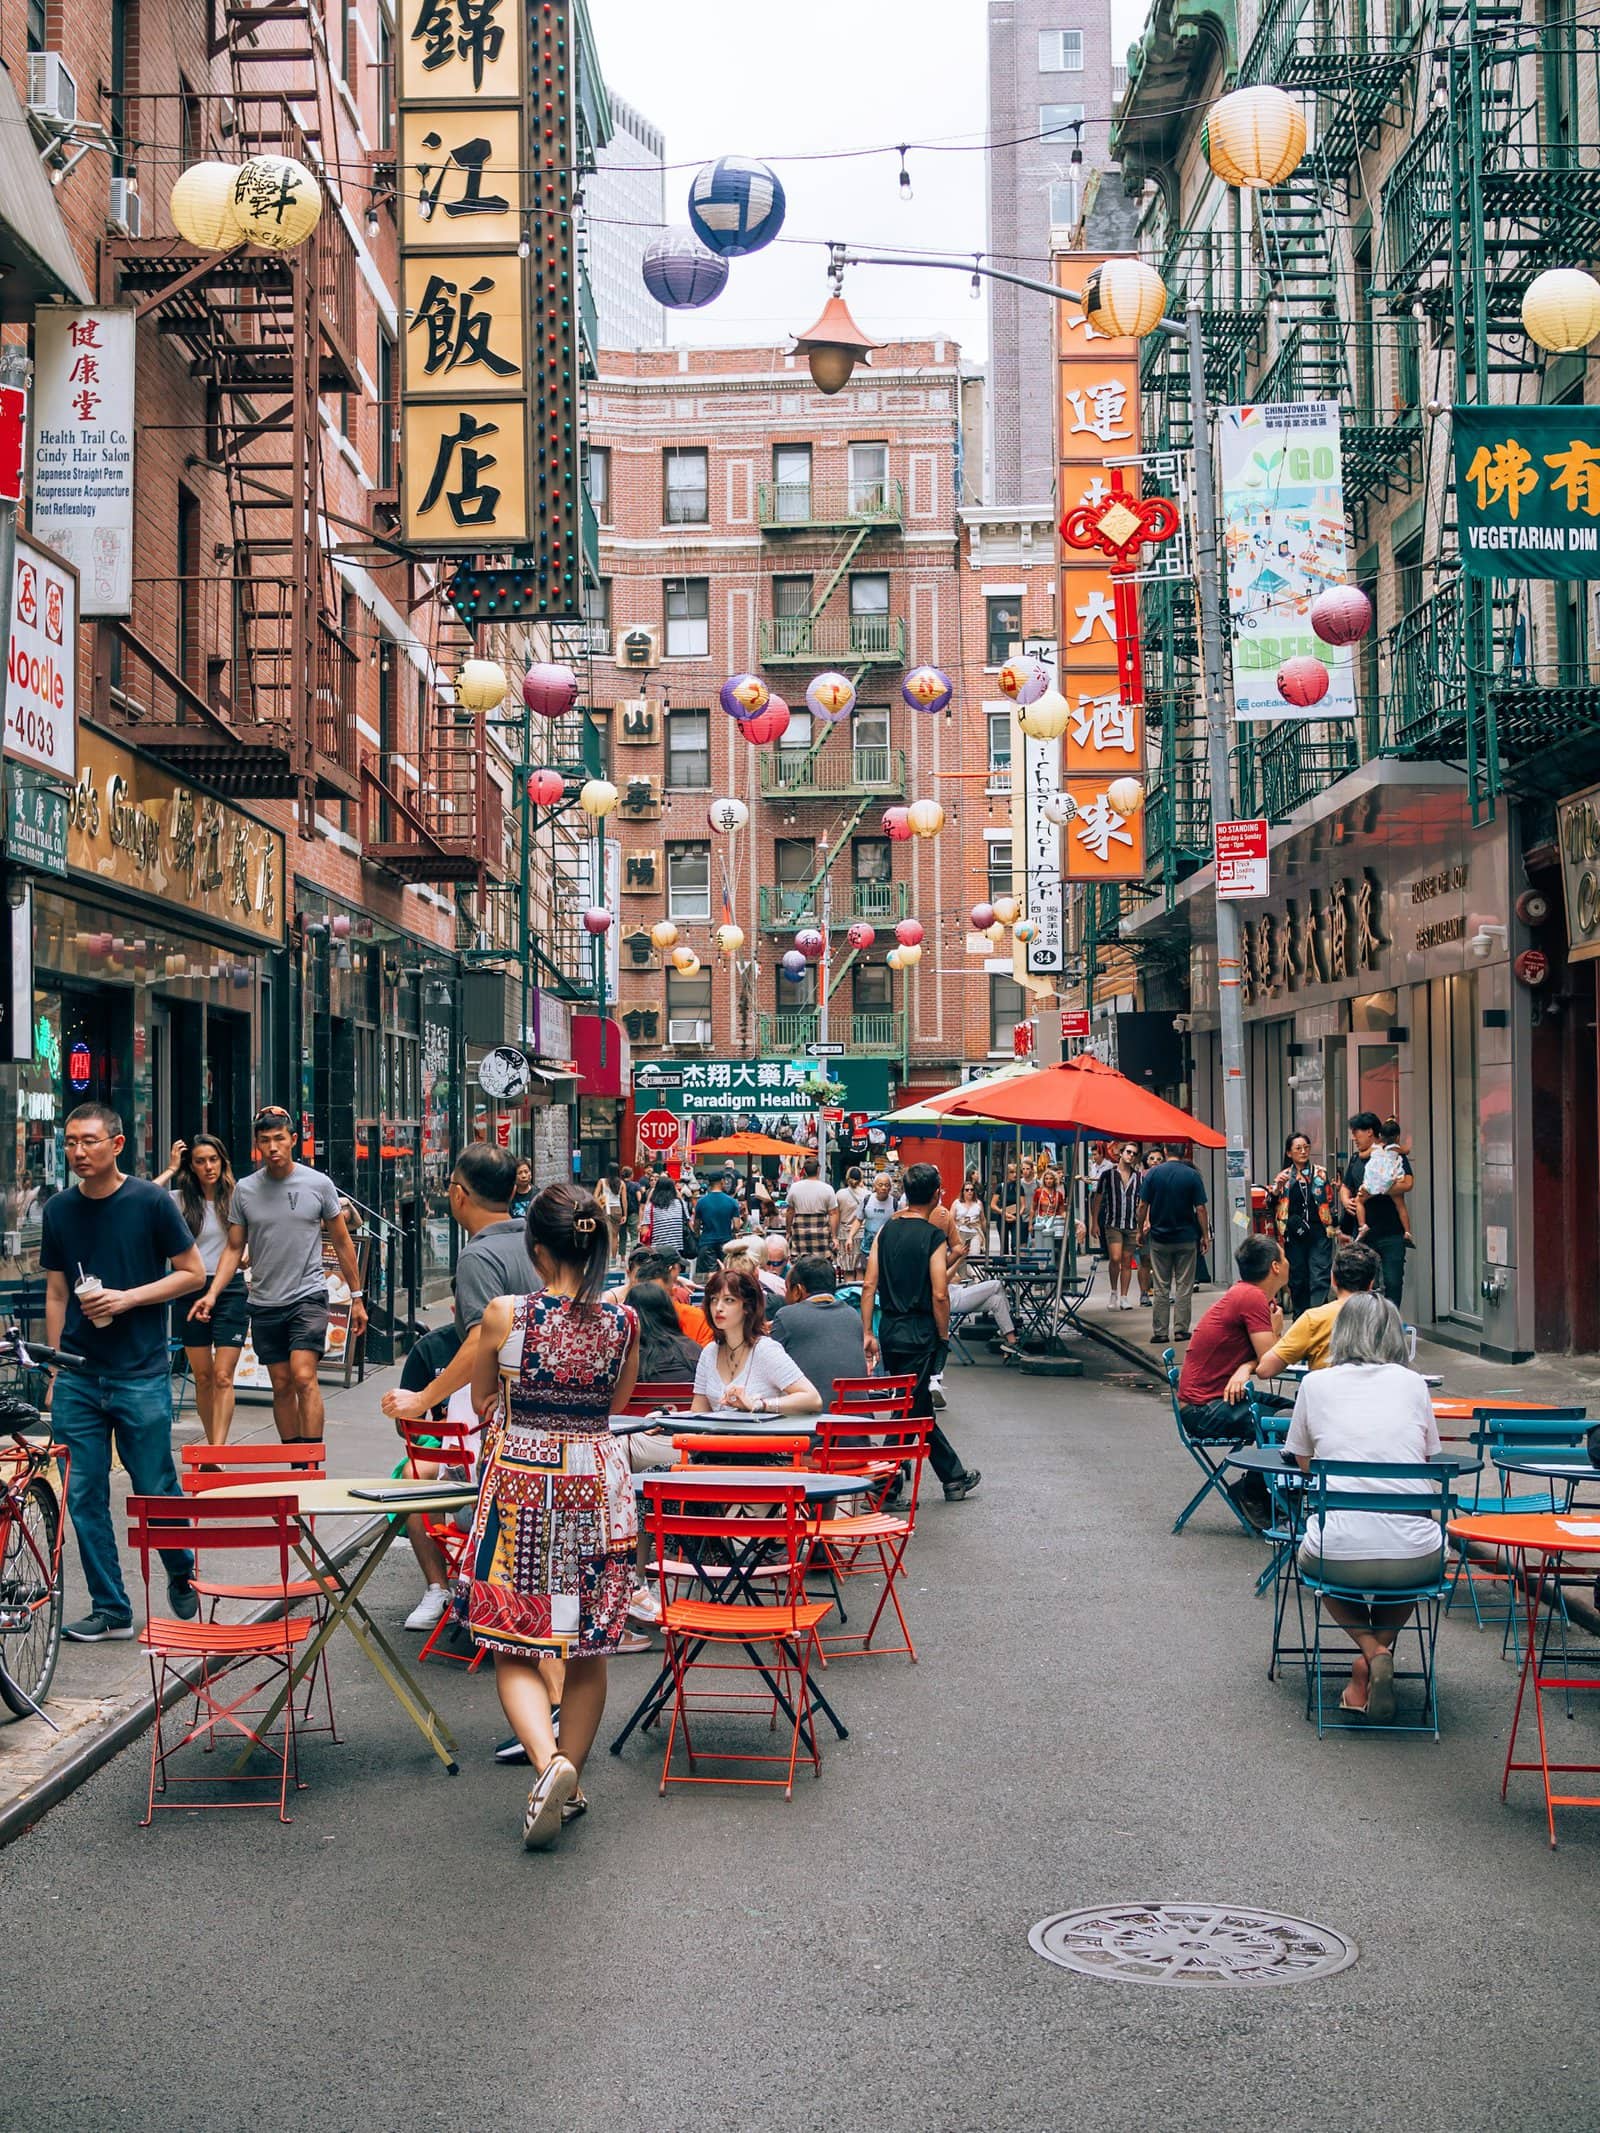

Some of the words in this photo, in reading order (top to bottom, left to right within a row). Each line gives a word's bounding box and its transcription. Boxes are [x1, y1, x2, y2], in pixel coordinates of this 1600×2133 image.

[408, 0, 521, 527] 錦江飯店
[66, 319, 104, 420] 健康堂
[1265, 404, 1309, 415] CHINATOWN
[40, 430, 75, 444] Health
[81, 430, 105, 444] Trail
[110, 430, 128, 444] Co.
[36, 448, 67, 466] Cindy
[73, 448, 97, 462] Hair
[102, 448, 130, 462] Salon
[1289, 446, 1334, 480] GO
[36, 467, 71, 482] Japanese
[73, 467, 102, 482] Straight
[104, 468, 123, 480] Perm
[1465, 439, 1600, 520] 佛有
[36, 485, 82, 499] Acupressure
[84, 485, 130, 499] Acupuncture
[36, 503, 52, 515] Foot
[53, 503, 96, 518] Reflexology
[1468, 526, 1564, 550] VEGETARIAN
[1569, 528, 1597, 550] DIM
[1066, 315, 1136, 861] 運大酒家
[1251, 698, 1290, 708] conEdiso
[1034, 747, 1050, 814] ichuan
[68, 767, 99, 836] oe's
[106, 774, 160, 869] Ginger
[719, 806, 740, 832] 喜
[1218, 826, 1227, 834] NO
[1228, 824, 1259, 834] STANDING
[15, 821, 36, 845] HEALTH
[36, 829, 53, 851] TRAIL
[1412, 877, 1436, 904] HOUSE
[1438, 871, 1449, 893] OF
[1450, 865, 1467, 890] JOY
[801, 935, 819, 947] 和
[1416, 916, 1467, 951] RESTAURANT
[1037, 952, 1052, 963] 34
[682, 1063, 806, 1088] 杰翔大藥房
[683, 1093, 756, 1110] Paradigm
[760, 1093, 811, 1107] Health
[641, 1123, 677, 1138] STOP
